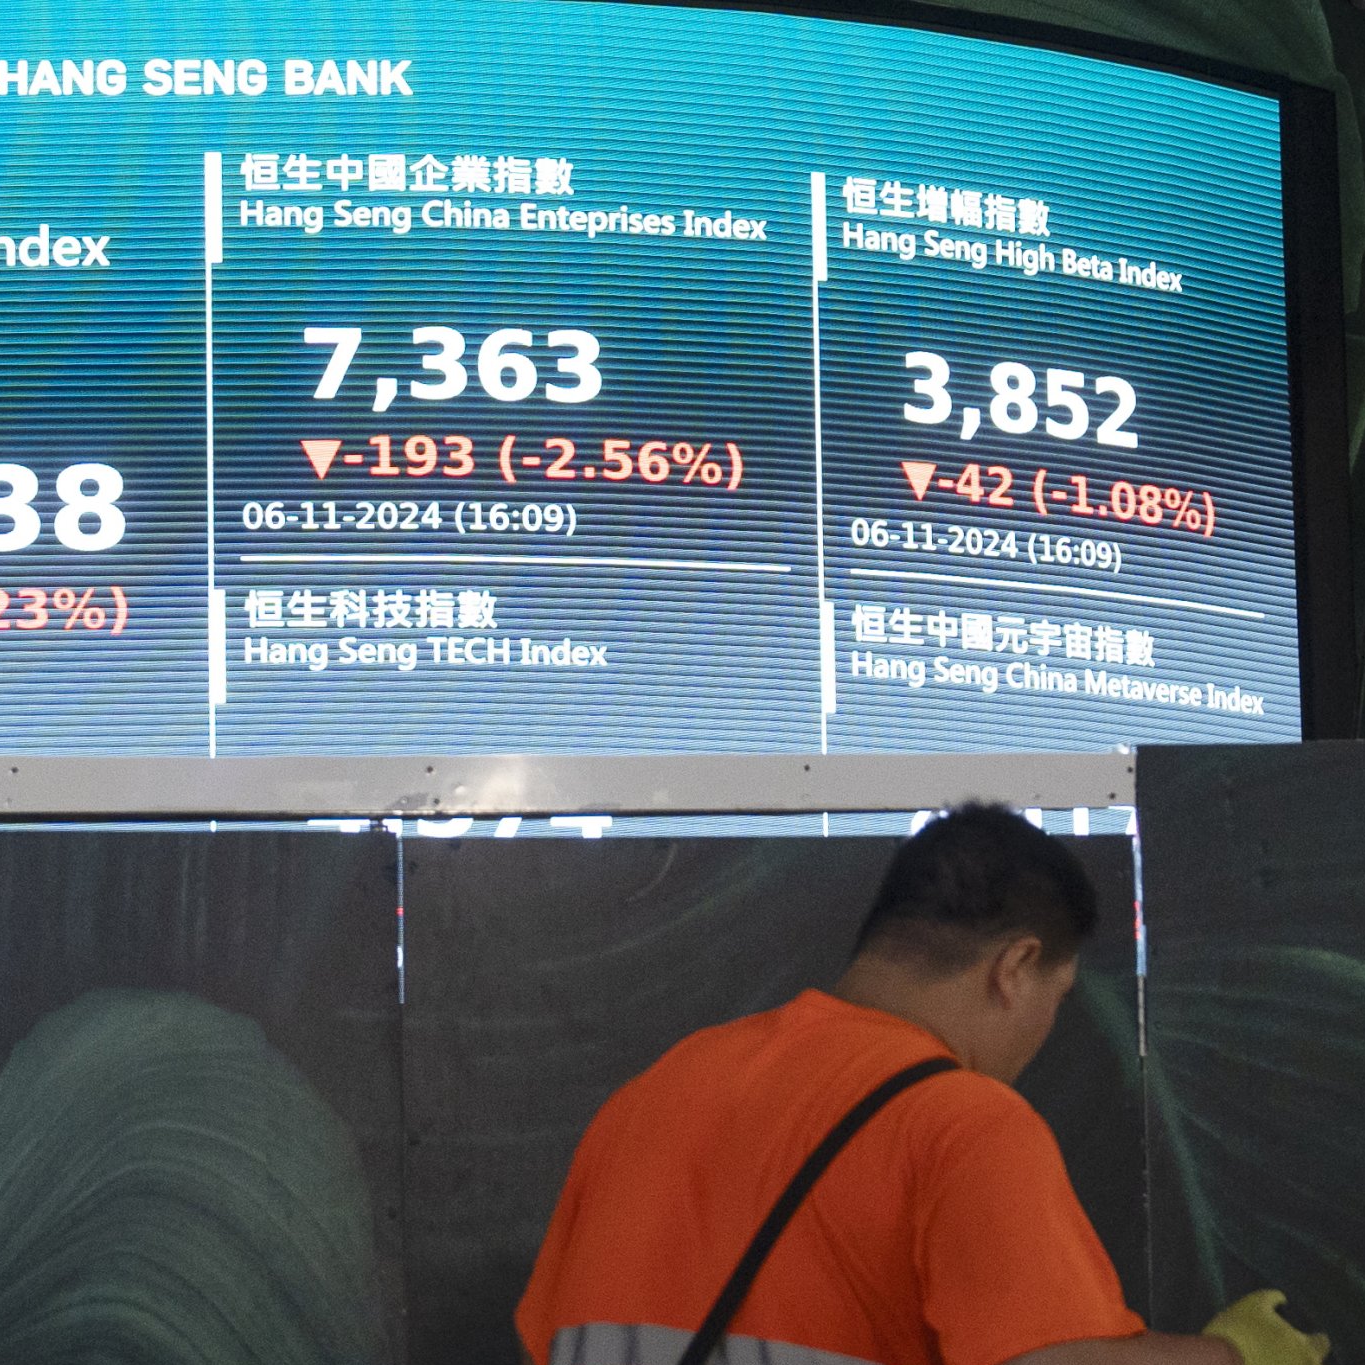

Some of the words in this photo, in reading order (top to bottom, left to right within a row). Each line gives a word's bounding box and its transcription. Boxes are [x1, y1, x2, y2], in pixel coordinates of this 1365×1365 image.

[141, 58, 268, 96] SENG
[284, 59, 413, 96] BANK
[240, 153, 575, 195] 恒生中國企業指數
[240, 199, 324, 234] Hang
[334, 199, 412, 234] Seng
[421, 199, 511, 230] China
[520, 202, 676, 238] Enteprises
[683, 209, 767, 240] Index
[843, 176, 1050, 237] 恒生增幅指數
[843, 221, 916, 260] Hang
[924, 230, 987, 270] Seng
[995, 239, 1055, 276] High
[1062, 248, 1113, 280] Beta
[1119, 258, 1183, 292] Index
[303, 326, 603, 412] 7,363
[903, 351, 1139, 449] 3,852
[343, 434, 475, 479] -193
[498, 435, 744, 491] (-2.56%)
[242, 501, 443, 530] 06-11-2024
[454, 501, 578, 537] (16:09)
[937, 463, 1014, 507] -42
[1033, 468, 1216, 538] (-1.08%)
[850, 518, 1018, 559] 06-11-2024
[1027, 533, 1123, 574] (16:09)
[244, 588, 498, 629] 恒生科技指數
[851, 603, 1155, 668] 恒生中國元宇宙指數
[244, 636, 329, 671] Hang
[338, 636, 418, 671] Seng
[426, 636, 511, 665] TECH
[520, 637, 609, 667] Index
[851, 650, 925, 688] Hang
[934, 656, 999, 693] Seng
[1005, 660, 1078, 693] China
[1083, 669, 1202, 707] Metaverse
[1206, 683, 1265, 715] Index
